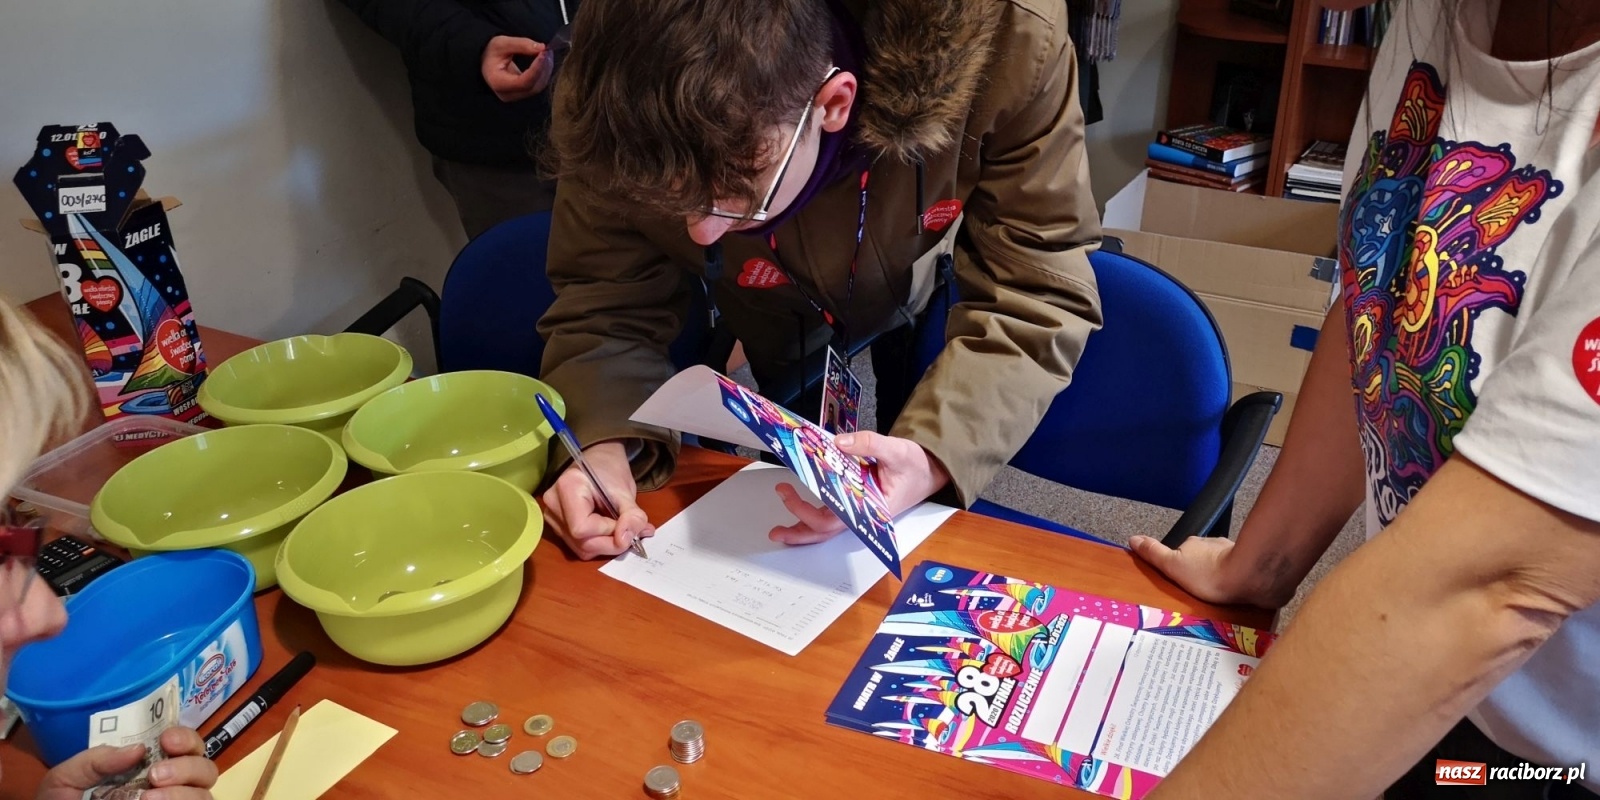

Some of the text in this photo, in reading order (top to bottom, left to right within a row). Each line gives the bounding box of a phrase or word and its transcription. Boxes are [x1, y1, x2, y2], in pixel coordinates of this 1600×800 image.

[125, 222, 161, 249] ŻAGLE
[931, 569, 946, 581] tvn
[1049, 613, 1069, 646] 12.01.2020
[853, 637, 905, 711] WIATR W ŻAGLE
[150, 698, 164, 723] 10
[957, 666, 1000, 726] 28
[1005, 668, 1044, 734] ROZLICZENIE
[988, 708, 1000, 723] 2020
